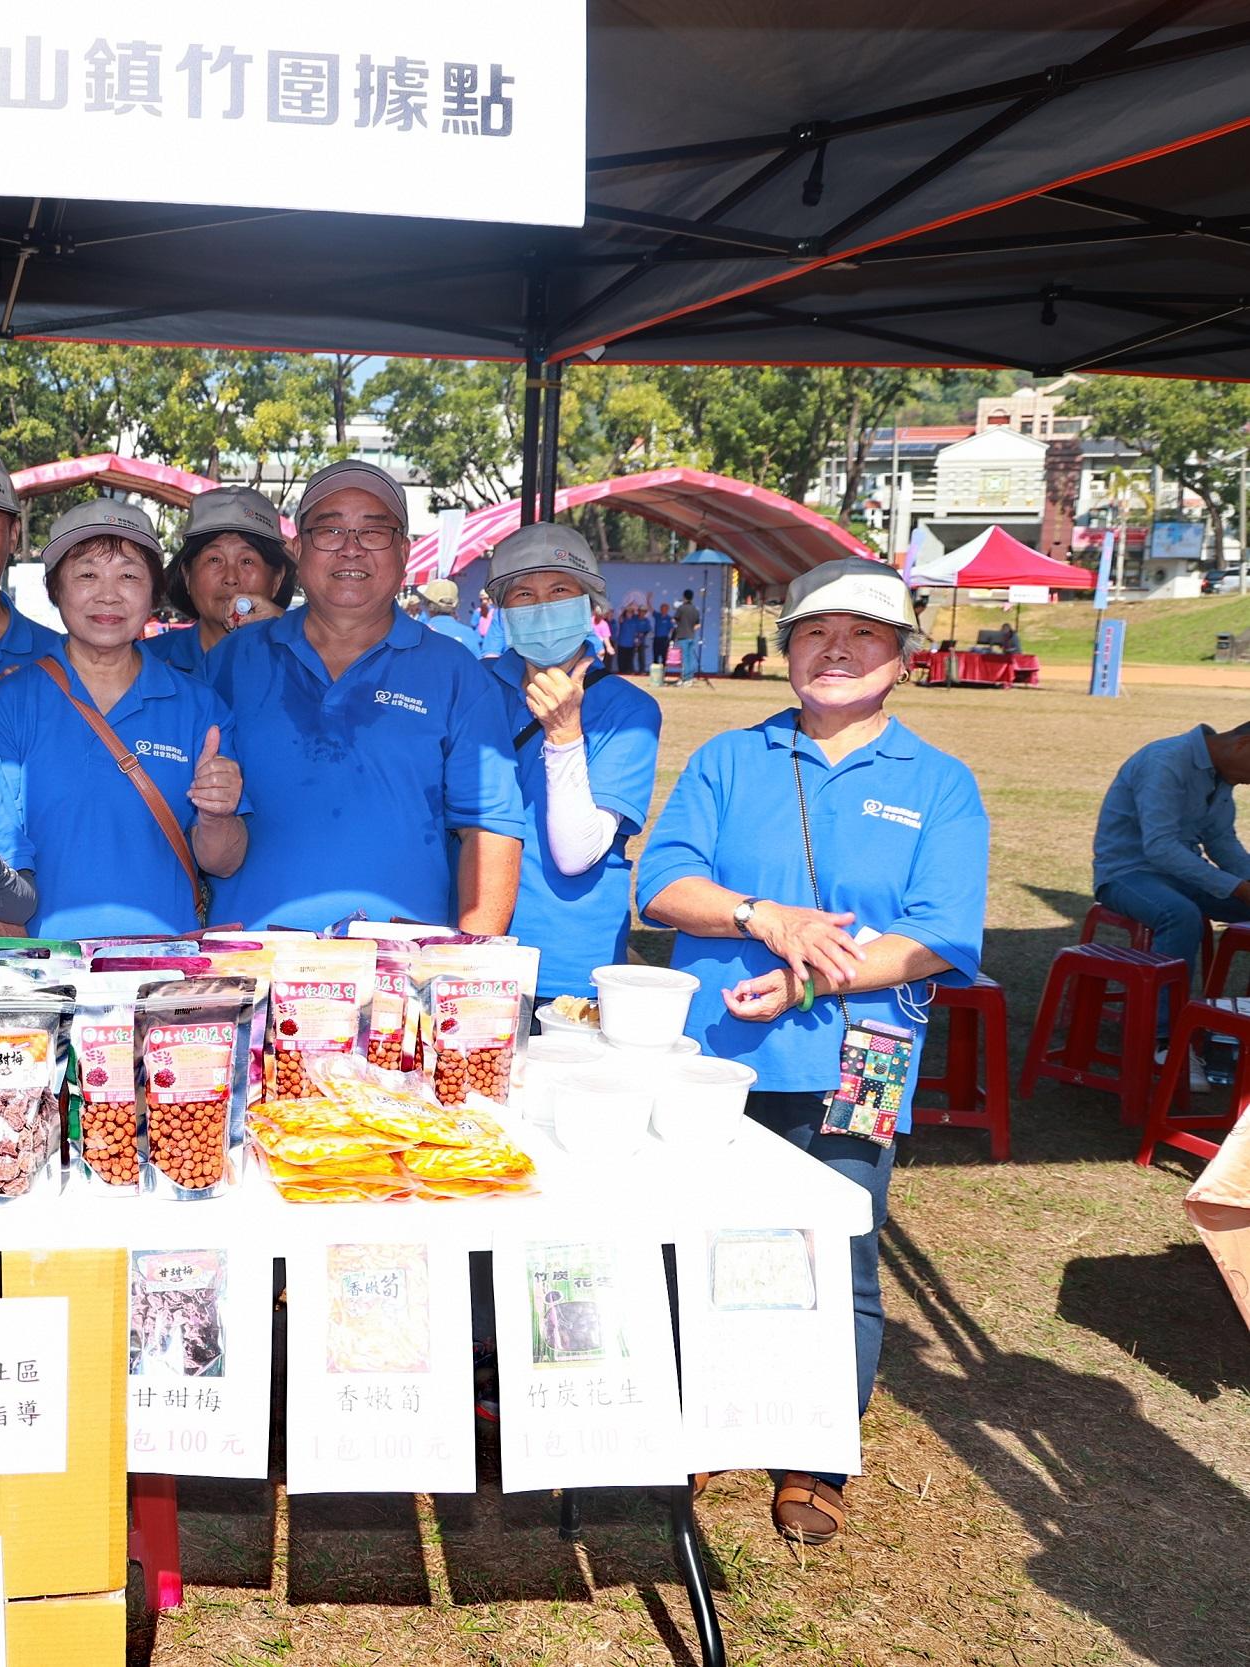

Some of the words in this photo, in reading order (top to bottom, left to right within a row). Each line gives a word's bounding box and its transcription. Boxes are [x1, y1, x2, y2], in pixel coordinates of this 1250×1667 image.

[132, 1386, 223, 1412] 甘甜梅
[336, 1384, 421, 1412] 香嫩筍
[526, 1378, 644, 1408] 竹炭花生
